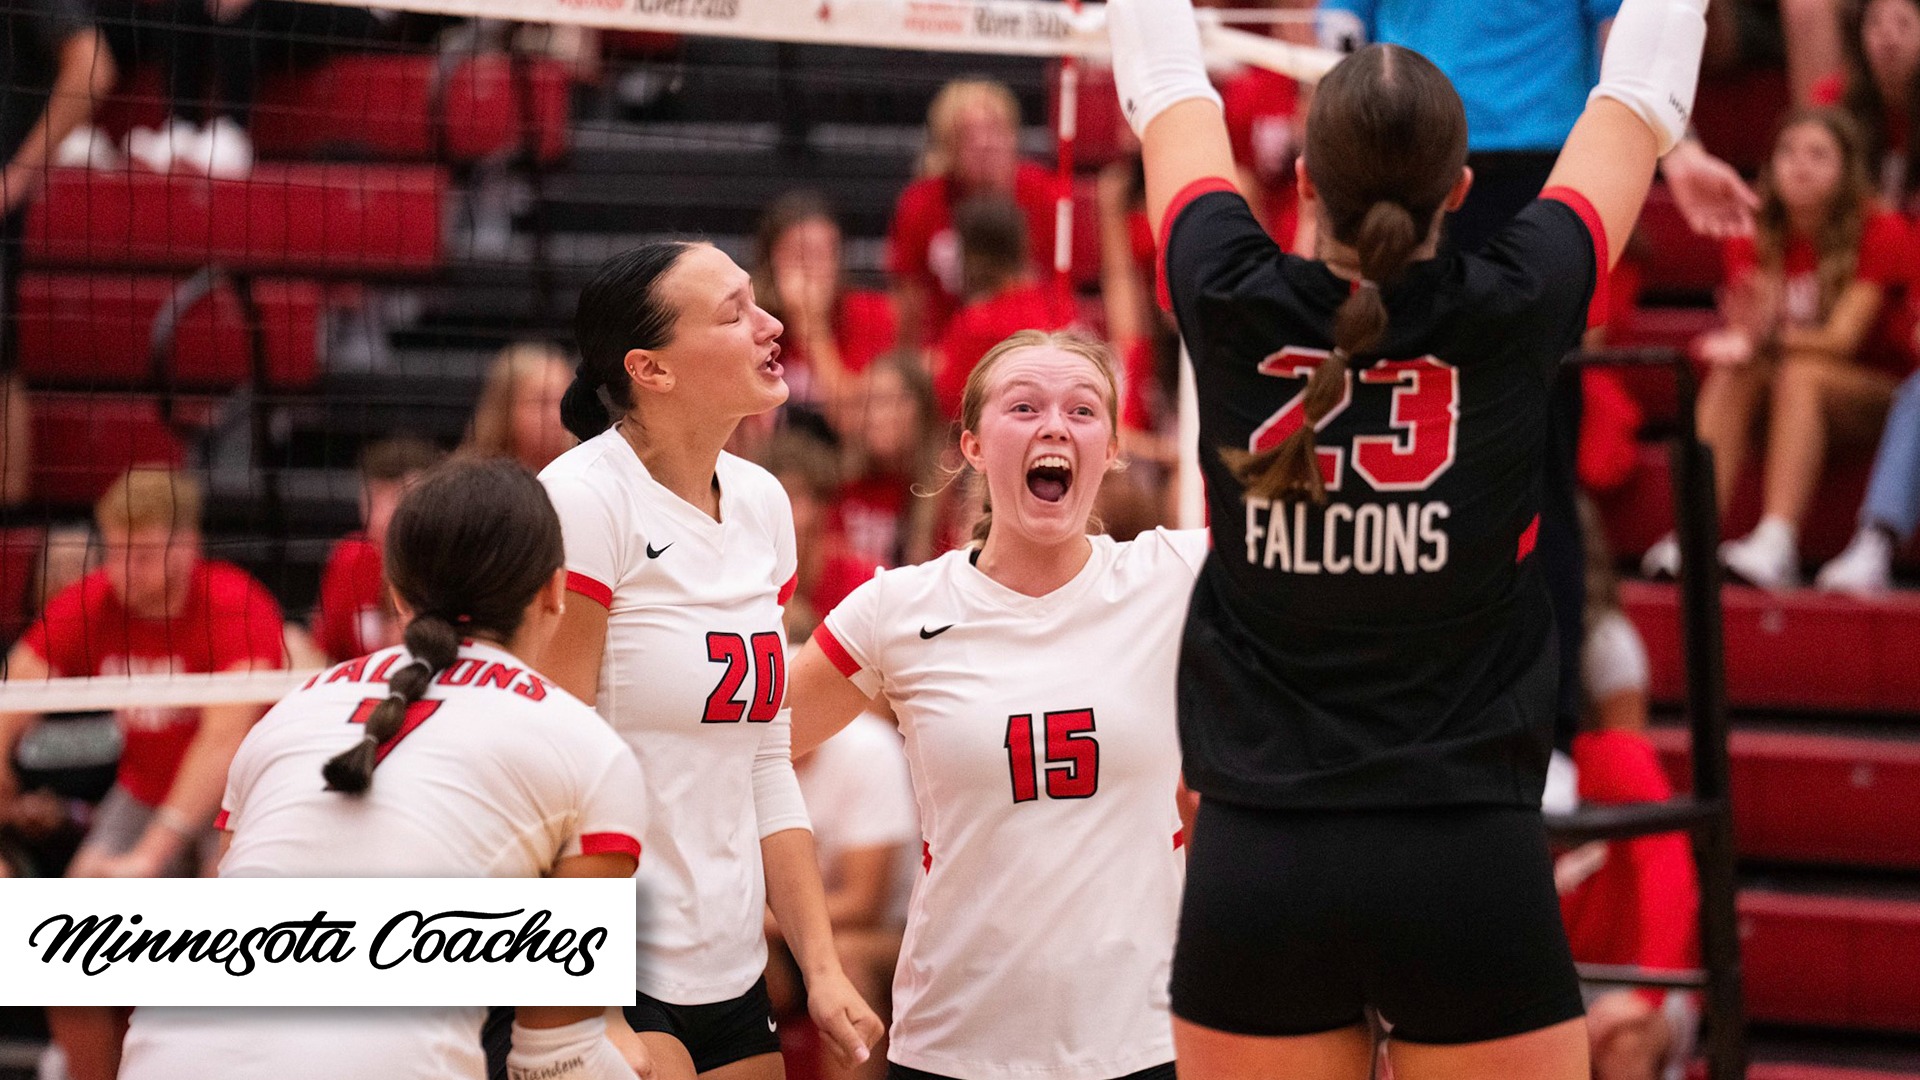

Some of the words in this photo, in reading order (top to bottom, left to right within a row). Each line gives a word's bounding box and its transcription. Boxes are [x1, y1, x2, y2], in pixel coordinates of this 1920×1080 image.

[1249, 345, 1460, 492] 23
[1246, 497, 1451, 575] FALCONS
[301, 653, 549, 703] ALONS
[701, 630, 785, 723] 20
[347, 697, 446, 774] 7
[1004, 707, 1100, 804] 15
